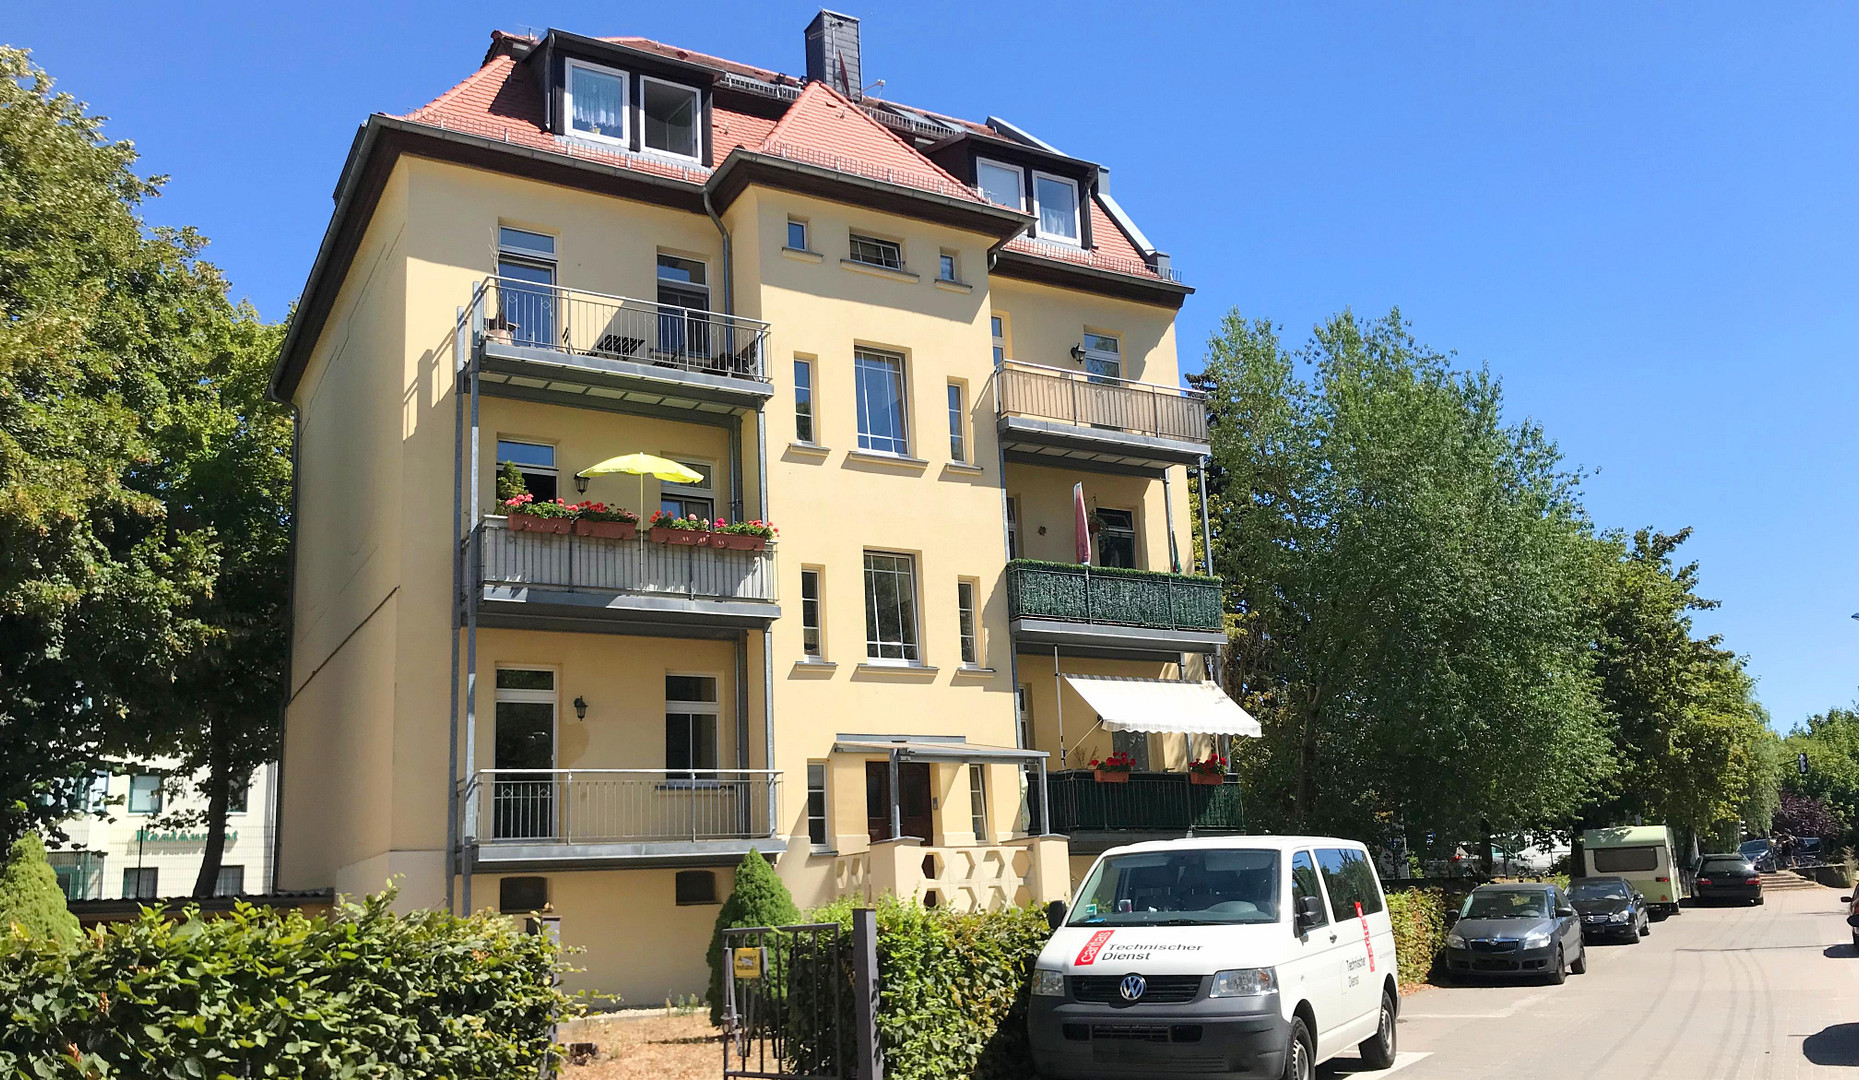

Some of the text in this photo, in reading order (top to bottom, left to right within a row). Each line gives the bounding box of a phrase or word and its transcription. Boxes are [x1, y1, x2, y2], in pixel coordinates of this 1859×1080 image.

[136, 830, 238, 842] Restaurt
[1080, 931, 1112, 963] caritas
[1109, 943, 1205, 952] Technischer
[1101, 952, 1151, 961] Dienst
